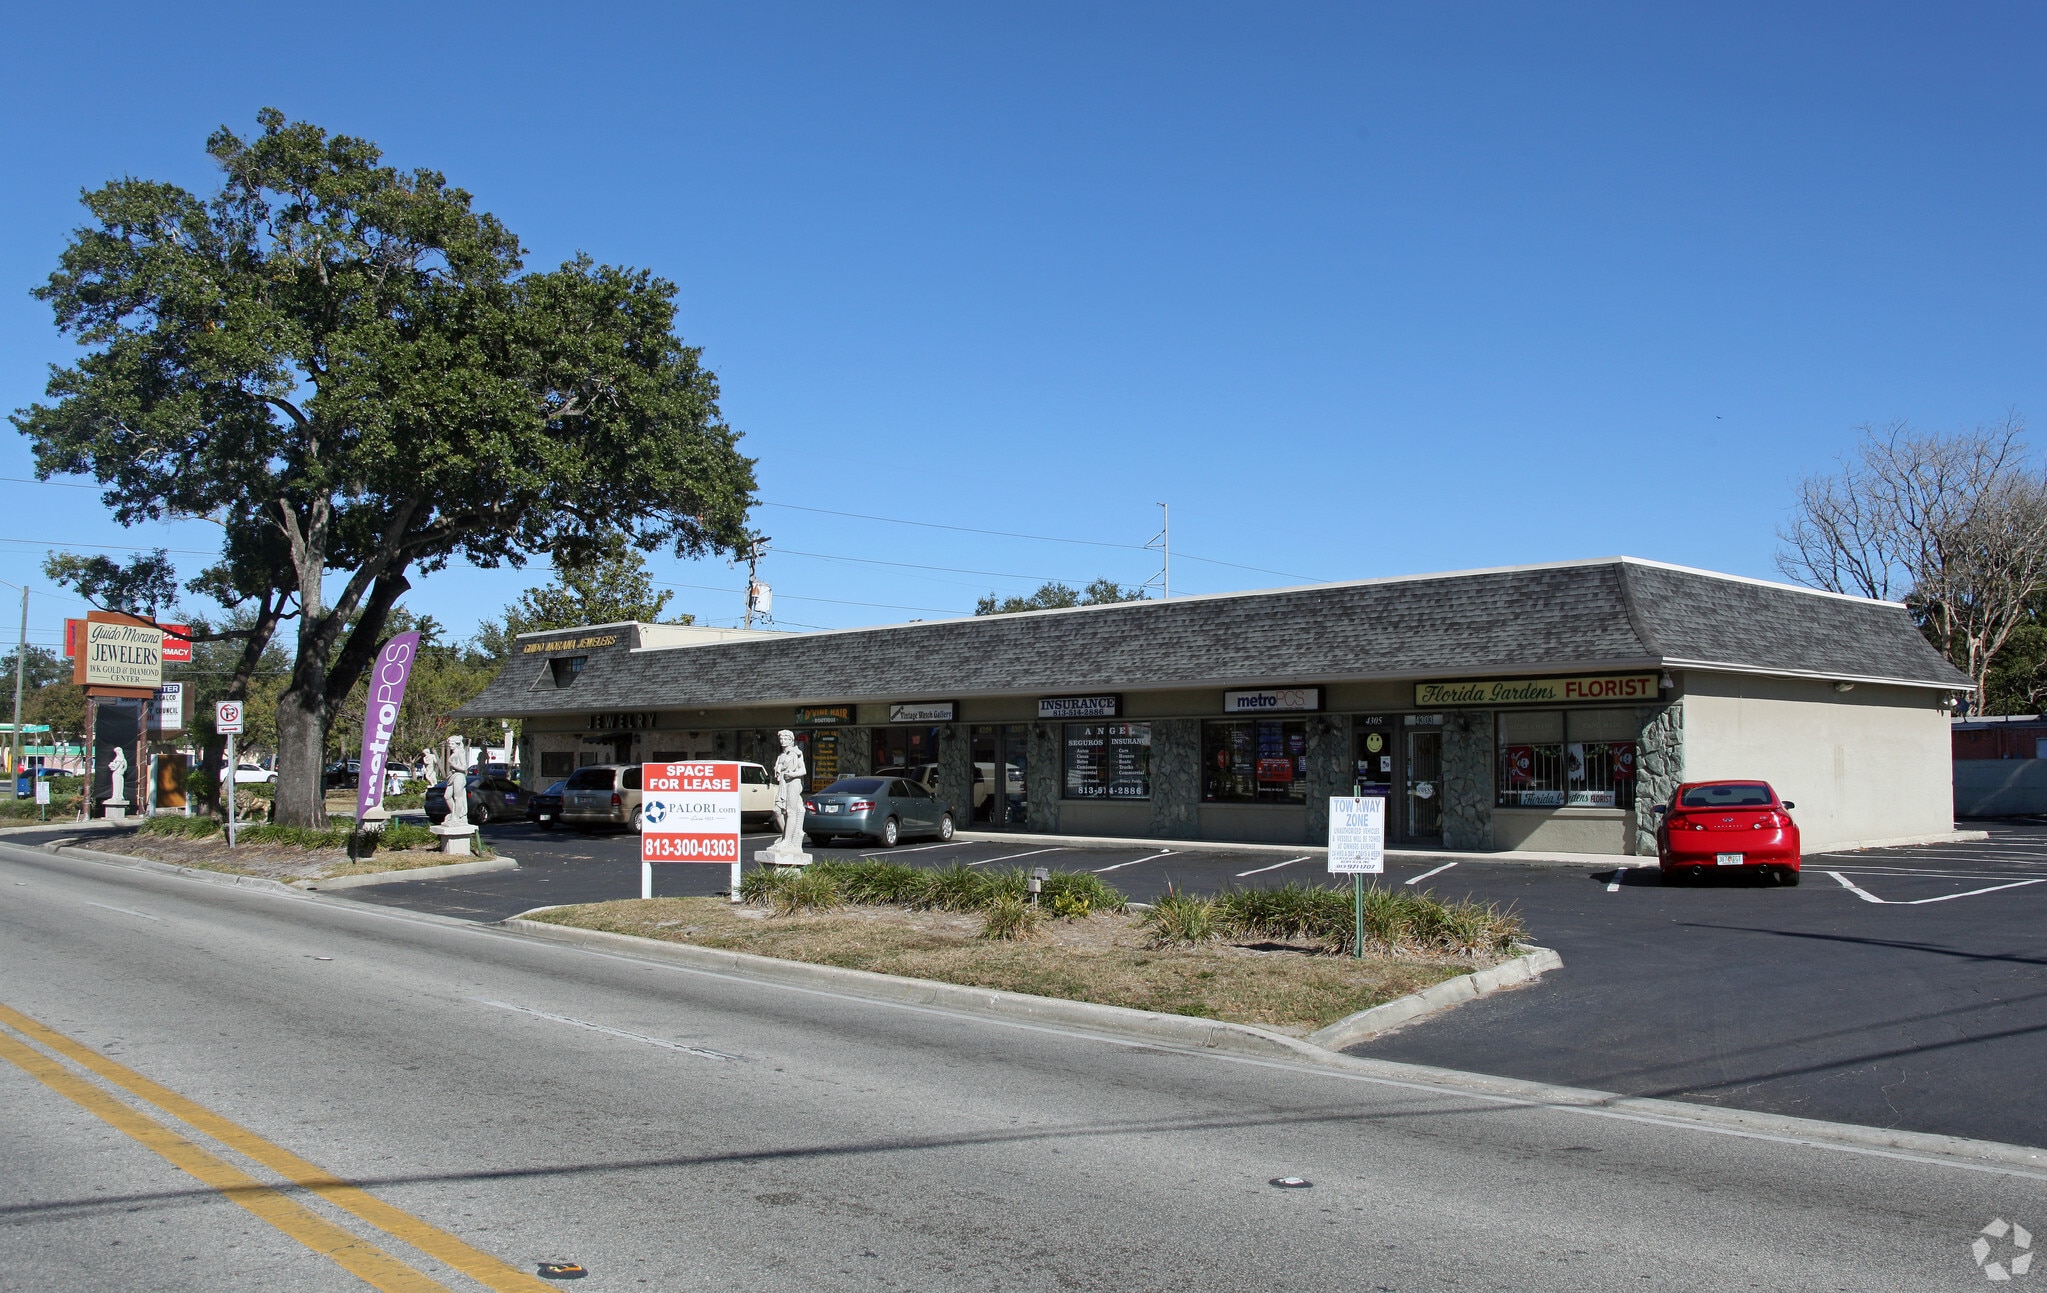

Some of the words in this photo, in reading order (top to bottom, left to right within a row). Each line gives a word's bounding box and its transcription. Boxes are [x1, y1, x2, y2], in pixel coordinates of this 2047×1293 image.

[90, 625, 120, 643] Guido
[120, 626, 160, 644] Morana
[524, 643, 544, 654] GUIDO
[577, 635, 617, 649] JEWELERS
[92, 644, 158, 666] JEWELERS
[102, 666, 121, 674] GOLD
[130, 668, 159, 676] DIAMOND
[1422, 685, 1484, 702] Florida
[1488, 682, 1556, 701] Gardens
[1565, 678, 1650, 698] FLORIST
[1041, 698, 1114, 710] INSURANCE
[1238, 690, 1304, 707] metroPCS
[830, 708, 848, 719] HAIR
[900, 711, 918, 720] Vintage
[934, 710, 951, 719] Gallery
[586, 713, 656, 729] JEWELRY
[1366, 717, 1382, 725] 4305
[666, 765, 714, 776] SPACE
[650, 779, 679, 789] FOR
[684, 779, 731, 790] LEASE
[1524, 792, 1554, 804] Florida
[1590, 795, 1612, 803] FLORIST
[1334, 800, 1354, 812] TOW
[1356, 800, 1380, 813] AWAY
[1346, 814, 1368, 826] ZONE
[645, 838, 735, 856] 813-300-0303
